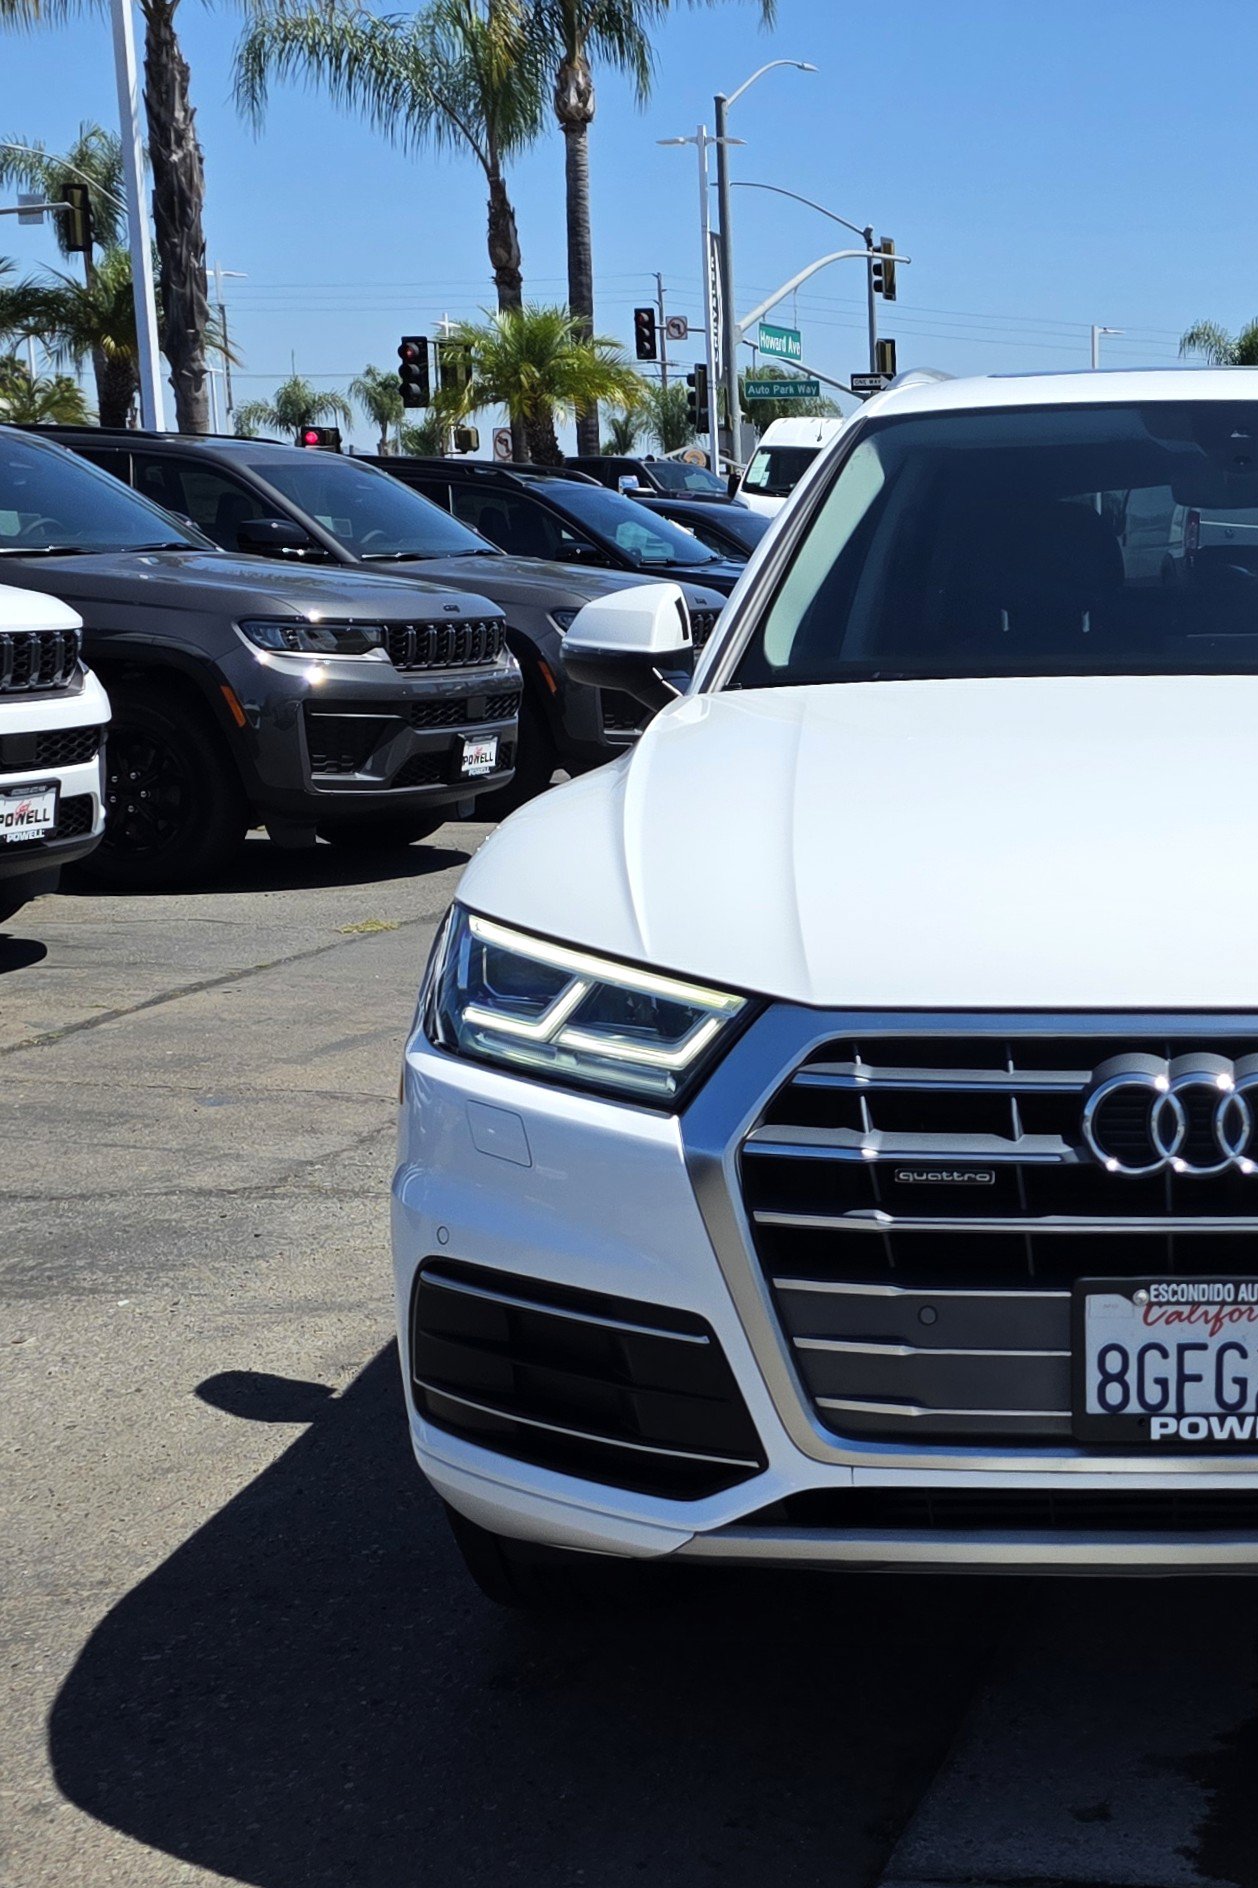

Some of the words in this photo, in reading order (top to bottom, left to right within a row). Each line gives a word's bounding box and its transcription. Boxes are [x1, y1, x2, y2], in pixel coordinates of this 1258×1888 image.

[760, 330, 786, 352] Howard
[788, 337, 801, 356] Ave
[748, 385, 770, 394] Auto
[773, 385, 794, 394] Park
[797, 385, 817, 395] Way
[6, 829, 45, 843] POWELL
[898, 1170, 991, 1183] quattro
[1150, 1283, 1236, 1302] ESCONDIDO
